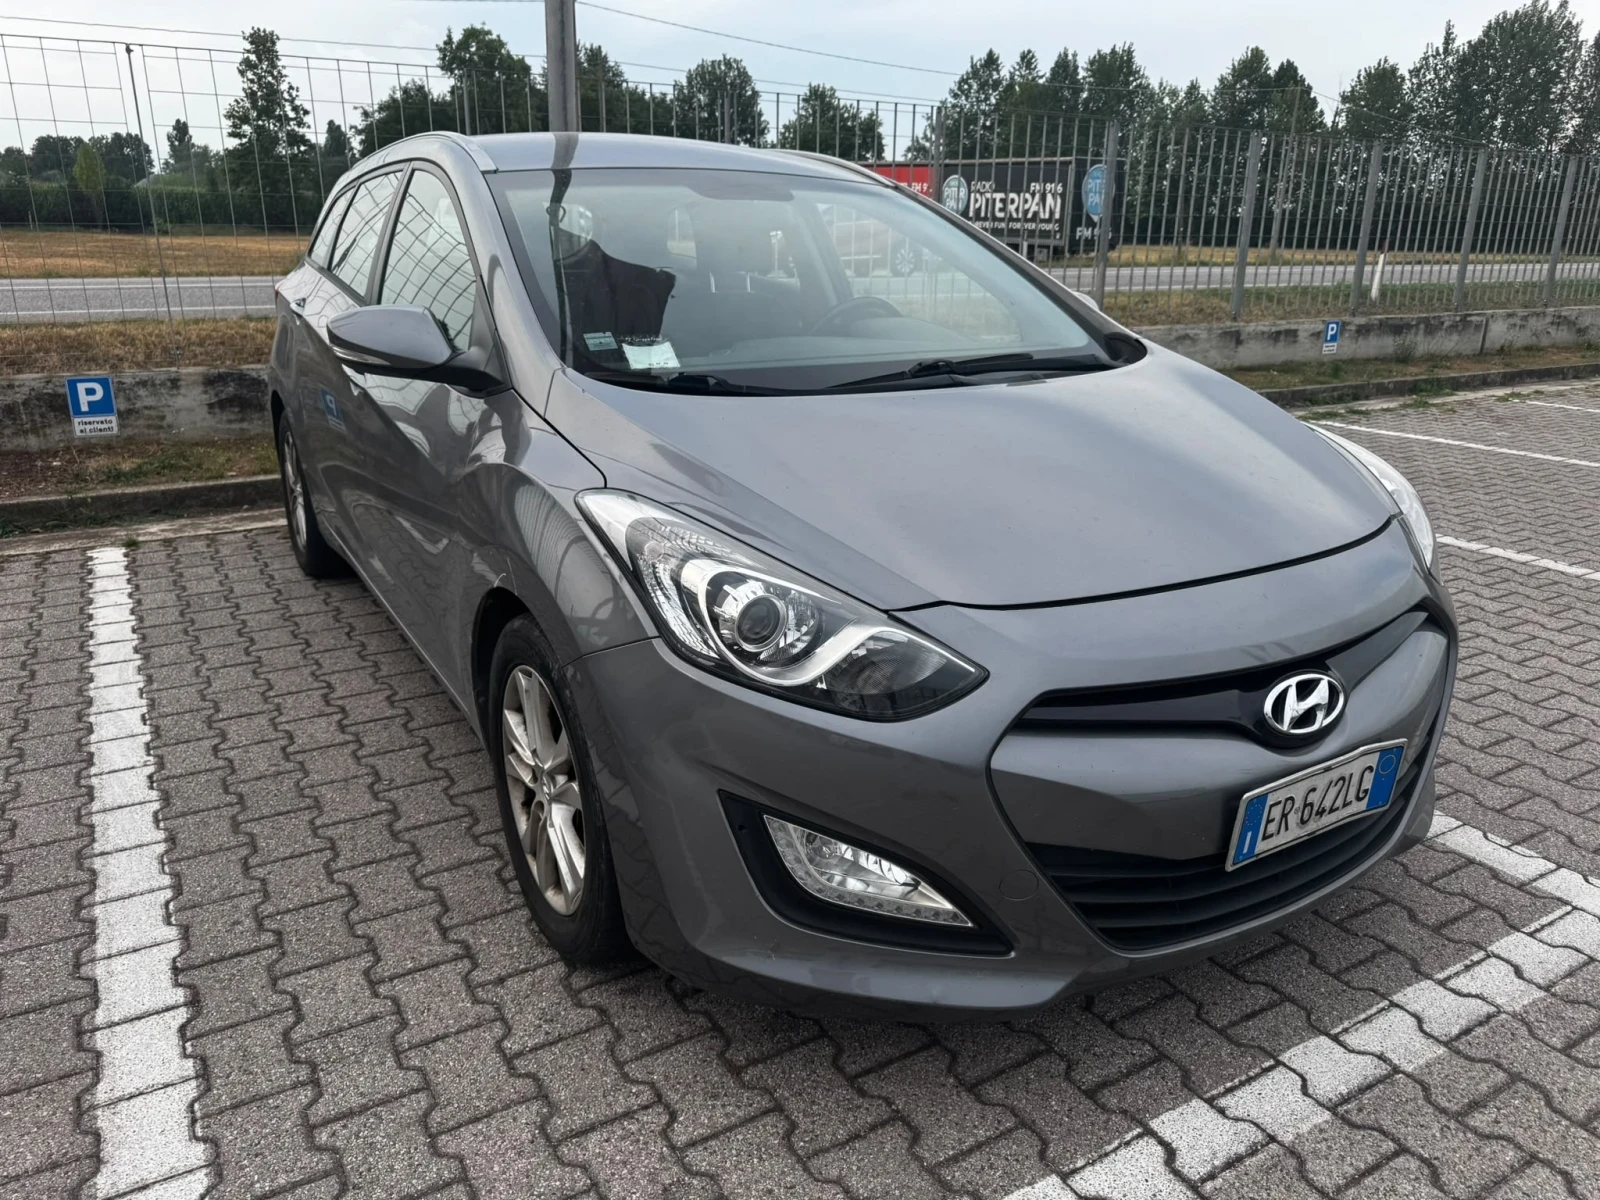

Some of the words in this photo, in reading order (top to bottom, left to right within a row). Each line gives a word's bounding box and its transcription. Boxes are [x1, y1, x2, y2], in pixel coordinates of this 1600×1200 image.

[969, 192, 1062, 219] PITERPAN
[1327, 323, 1337, 341] P
[76, 382, 104, 412] P
